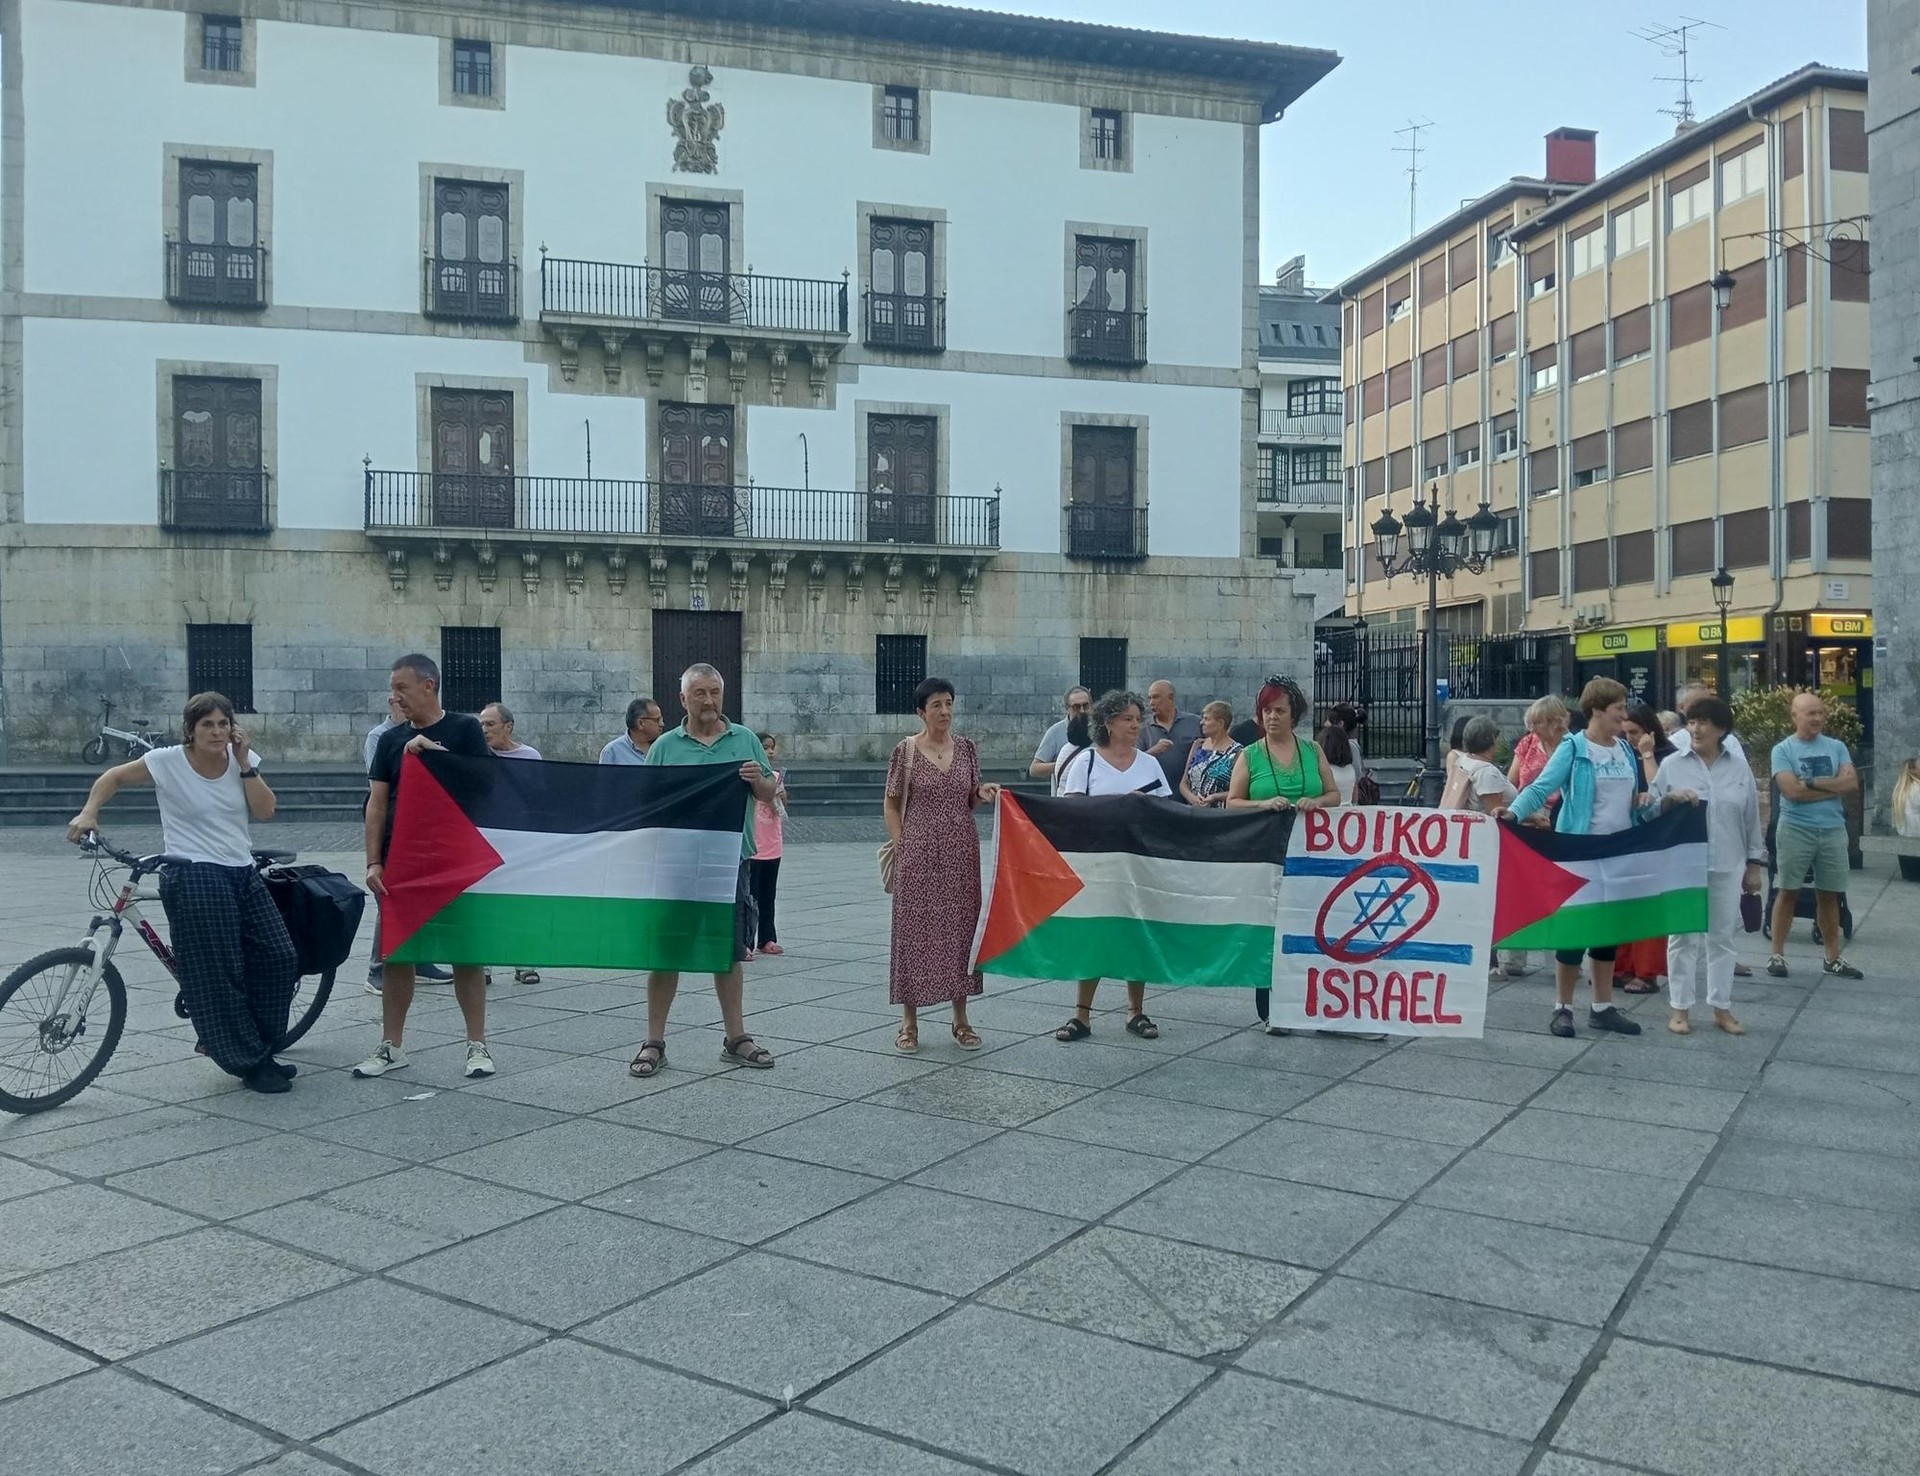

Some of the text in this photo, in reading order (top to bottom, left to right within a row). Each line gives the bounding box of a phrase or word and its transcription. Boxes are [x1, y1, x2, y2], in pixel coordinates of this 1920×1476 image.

[1612, 633, 1626, 647] BM
[1844, 621, 1861, 632] BM
[1305, 808, 1486, 860] BOIKOT
[1305, 967, 1462, 1024] ISRAEL
